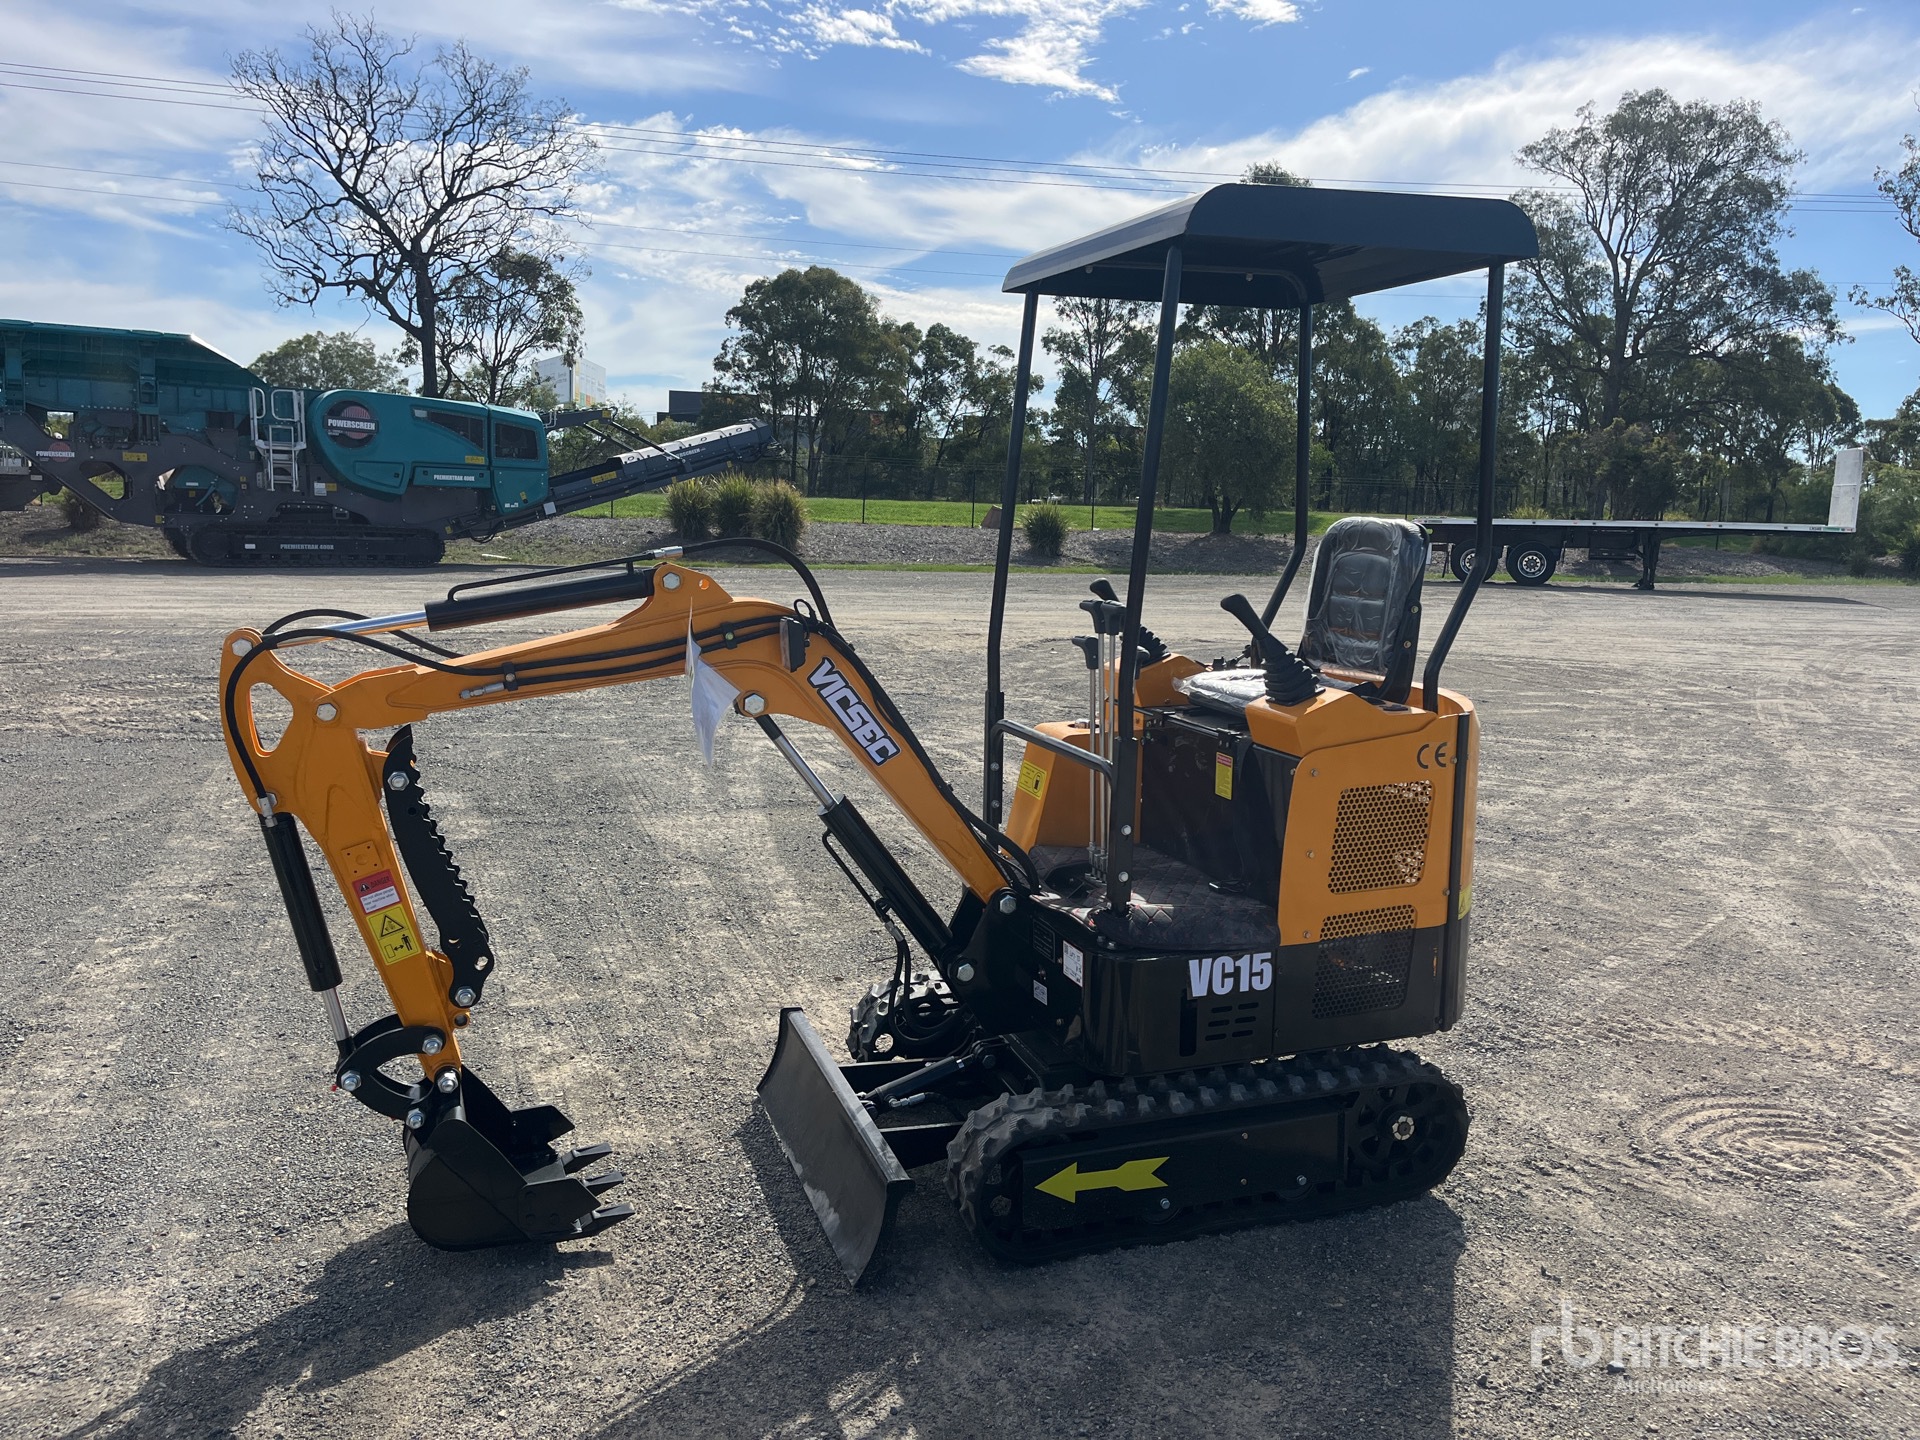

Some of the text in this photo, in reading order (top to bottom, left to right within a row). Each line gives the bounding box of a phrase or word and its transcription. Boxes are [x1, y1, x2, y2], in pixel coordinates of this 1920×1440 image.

[328, 418, 376, 430] POWERSCREEN
[807, 656, 901, 766] VICSEC
[1416, 741, 1448, 770] CE
[1188, 951, 1273, 997] VC15
